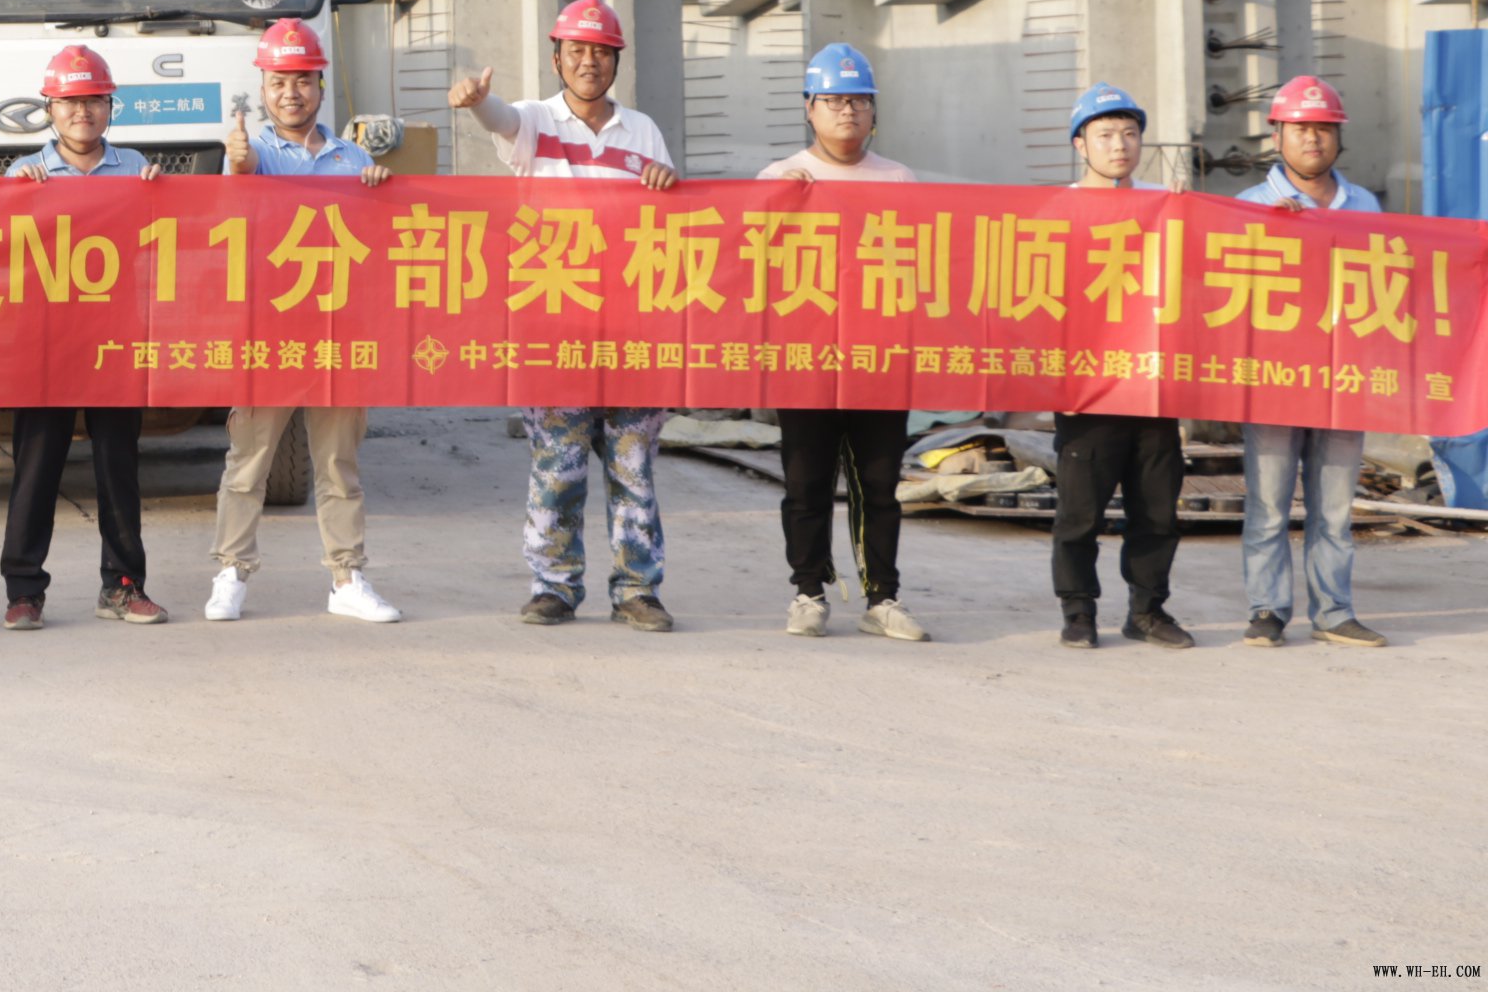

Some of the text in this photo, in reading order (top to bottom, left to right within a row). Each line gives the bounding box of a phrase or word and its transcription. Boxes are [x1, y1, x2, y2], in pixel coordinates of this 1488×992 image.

[133, 97, 206, 113] 中交二航局
[94, 339, 380, 371] 广西交通投资集团
[1425, 372, 1454, 402] 宣
